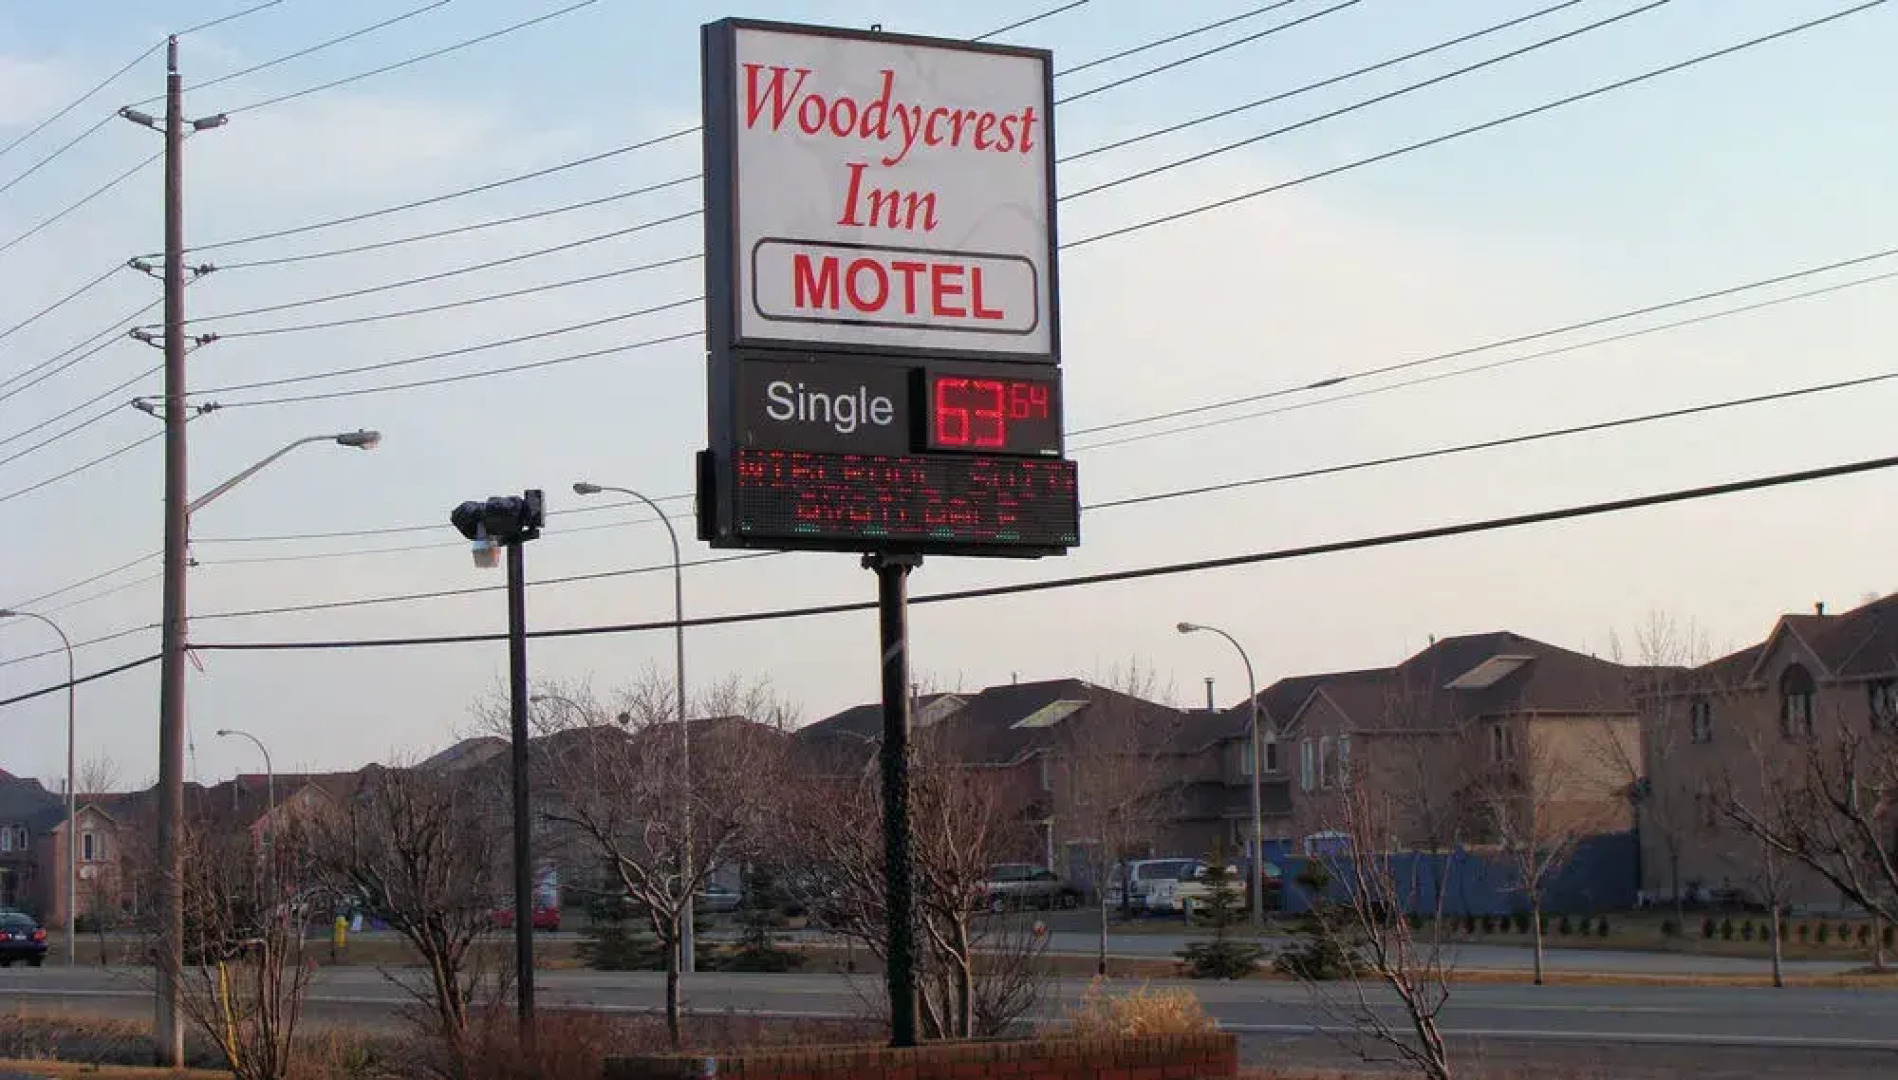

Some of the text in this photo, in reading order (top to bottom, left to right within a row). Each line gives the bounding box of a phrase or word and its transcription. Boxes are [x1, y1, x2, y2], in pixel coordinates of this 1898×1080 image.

[743, 63, 1038, 166] Woodycrest
[837, 162, 939, 232] Inn
[793, 254, 1004, 320] MOTEL
[766, 380, 894, 433] Single
[935, 377, 1006, 448] 63
